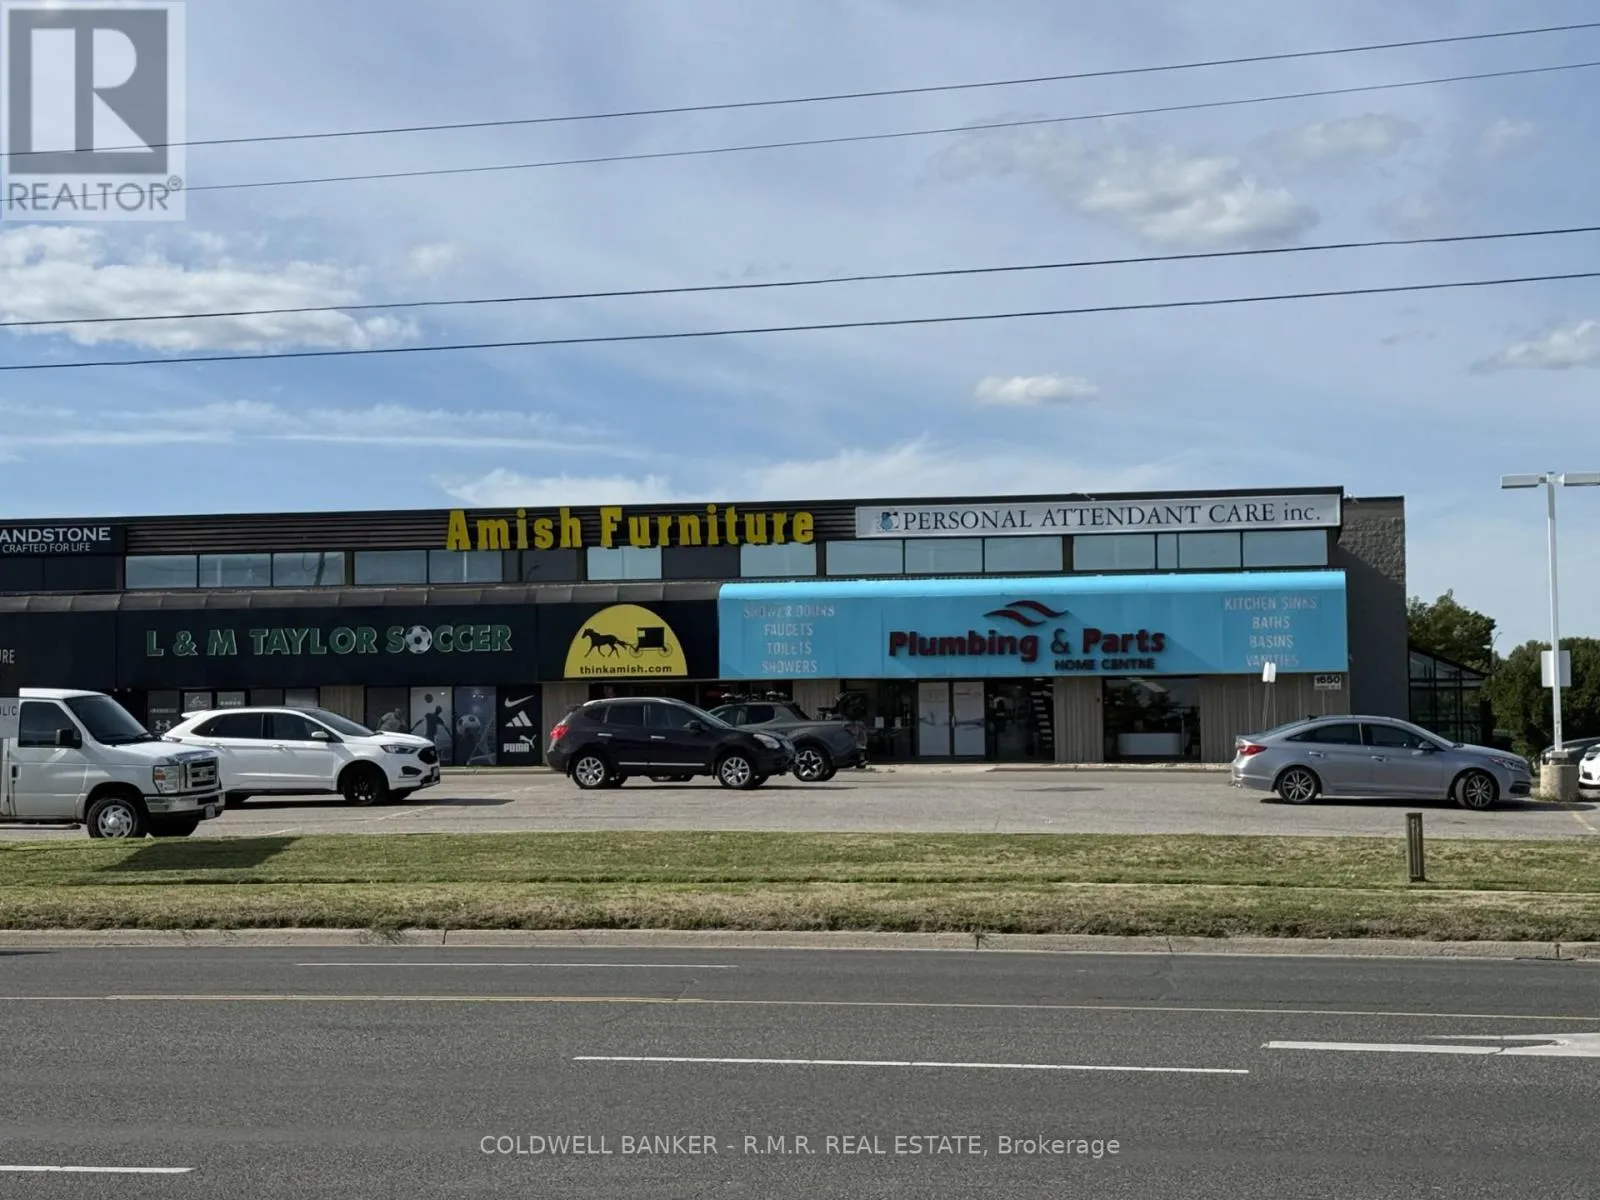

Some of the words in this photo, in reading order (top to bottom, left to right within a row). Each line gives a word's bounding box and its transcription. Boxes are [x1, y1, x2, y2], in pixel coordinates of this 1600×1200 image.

[903, 509, 1032, 530] PERSONAL
[1040, 505, 1202, 527] ATTENDANT
[1208, 503, 1275, 523] CARE
[1283, 502, 1321, 521] inc.
[446, 507, 584, 551] Amish
[599, 503, 815, 548] Furniture
[2, 543, 47, 554] CRAFTED
[49, 543, 70, 552] FOR
[71, 542, 91, 552] LIFE
[1224, 597, 1277, 610] KITCHEN
[764, 623, 814, 636] FAUCETS
[1251, 616, 1291, 630] BATHS
[147, 630, 165, 656] L
[172, 630, 199, 656] &
[206, 628, 238, 656] M
[248, 626, 379, 655] TAYLOR
[889, 630, 1039, 662] Plumbing
[1050, 628, 1071, 654] &
[1082, 628, 1166, 653] Parts
[1249, 635, 1294, 648] BASINS
[767, 641, 813, 655] TOILETS
[580, 664, 672, 675] thinkamish.com
[761, 660, 818, 673] SHOWERS
[1054, 659, 1097, 671] HOME
[1101, 658, 1156, 670] CENTRE
[503, 743, 530, 753] PUMA
